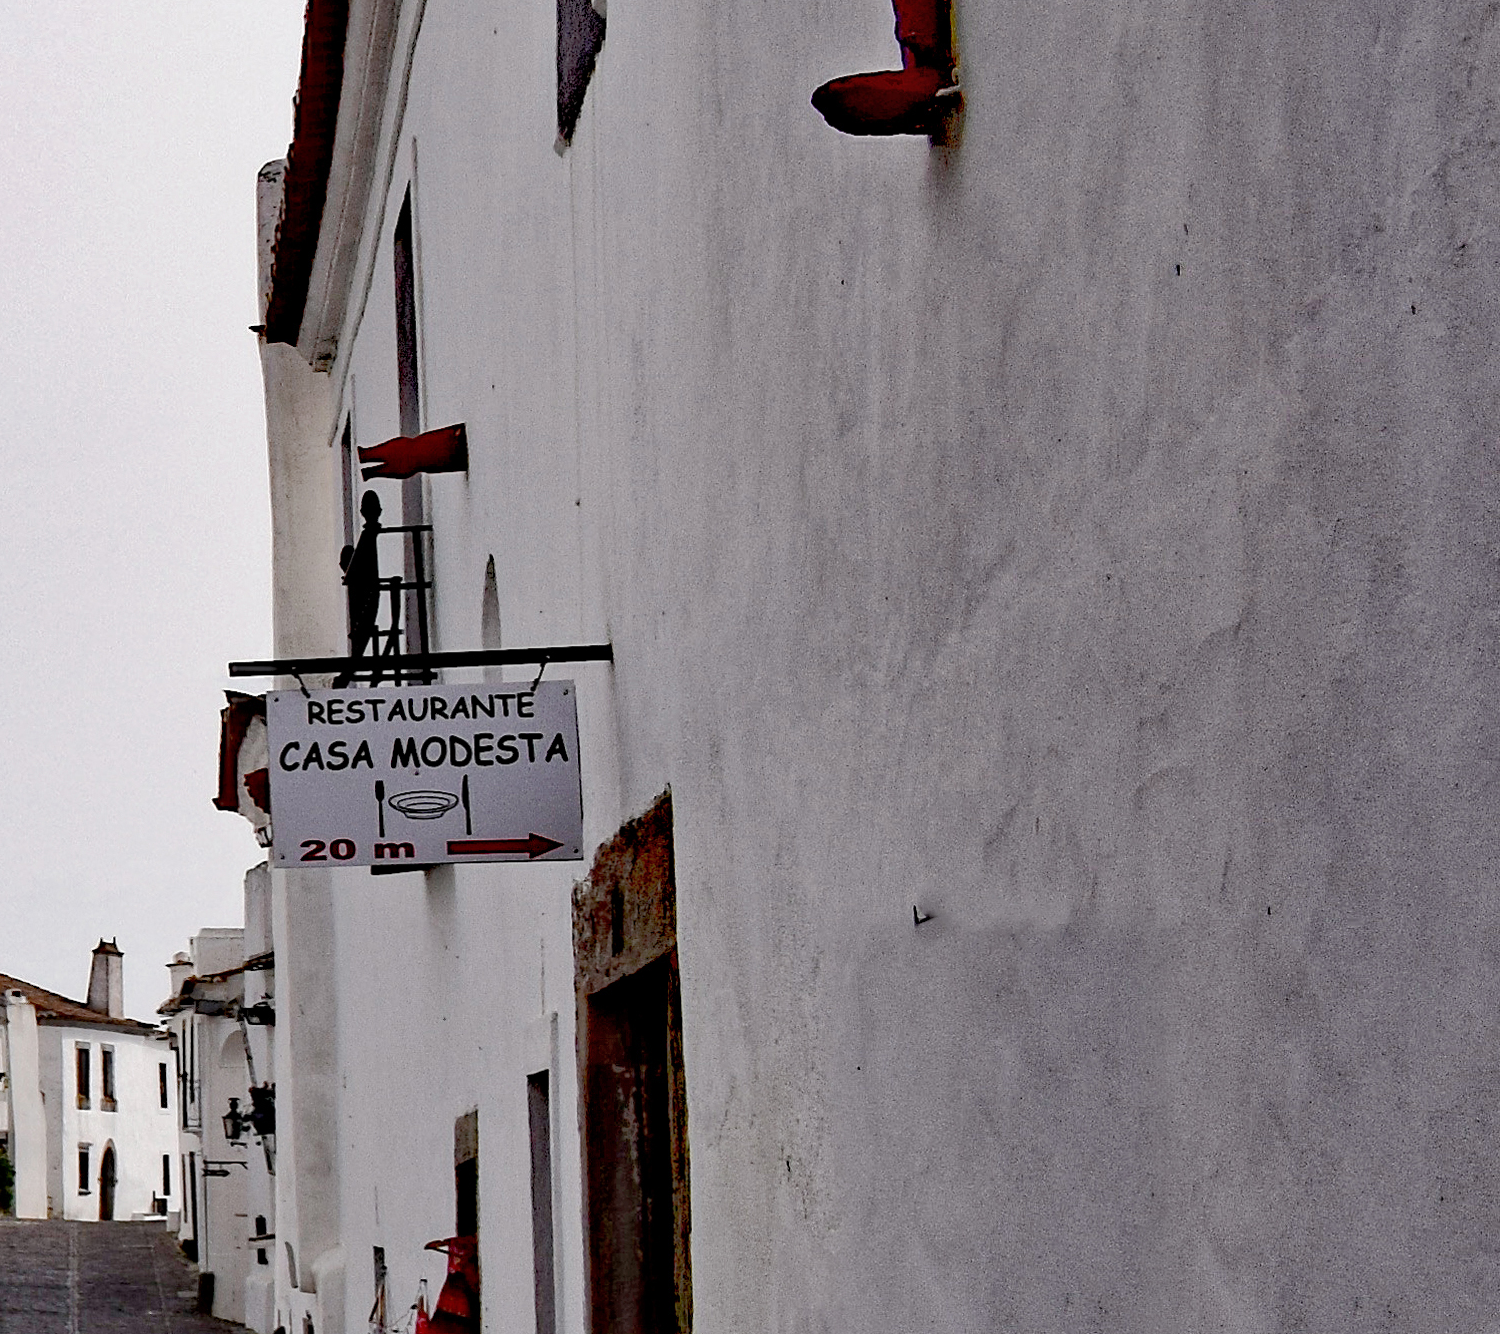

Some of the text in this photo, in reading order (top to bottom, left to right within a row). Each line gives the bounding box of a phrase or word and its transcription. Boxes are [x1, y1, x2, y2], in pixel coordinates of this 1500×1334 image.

[307, 692, 535, 725] RESTAURANTE
[279, 732, 569, 771] CASA MODESTA
[300, 838, 416, 862] 20 m
